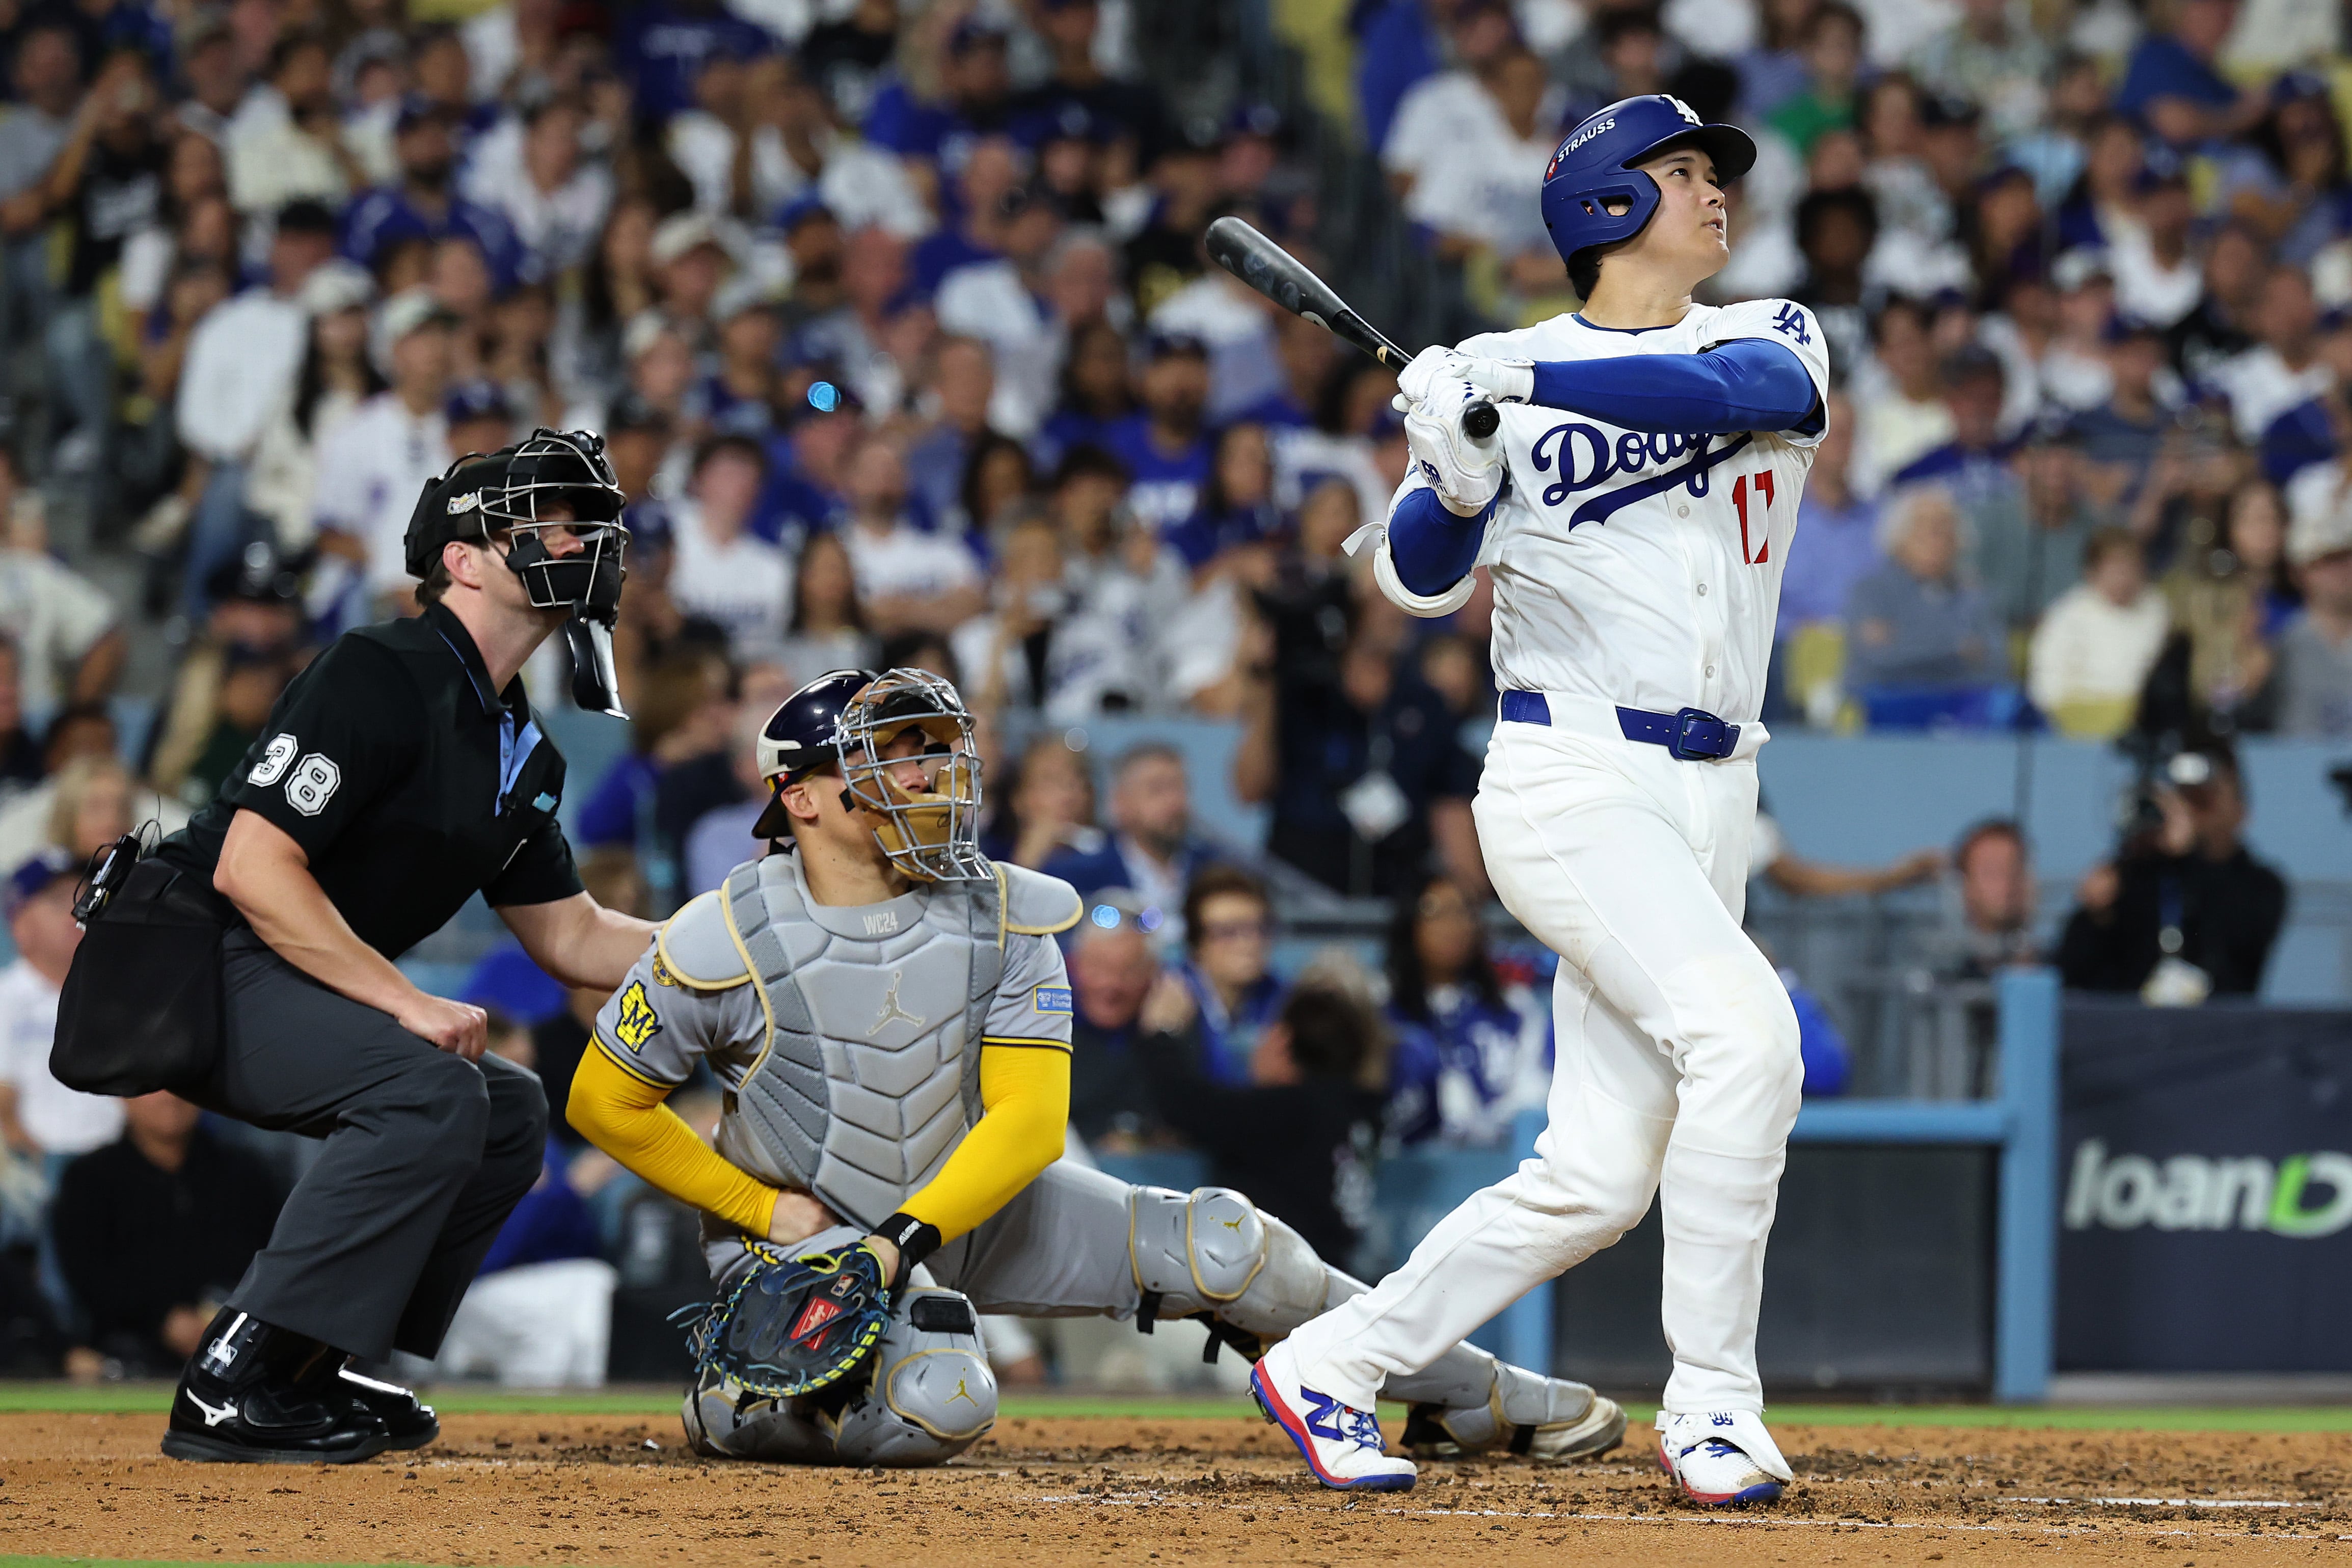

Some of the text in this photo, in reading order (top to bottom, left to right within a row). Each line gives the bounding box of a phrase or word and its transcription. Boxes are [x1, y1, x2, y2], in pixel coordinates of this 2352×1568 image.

[1558, 118, 1616, 163] STRAUSS
[1772, 303, 1811, 346] LA
[1732, 469, 1774, 565] 17
[248, 732, 341, 817] 38
[863, 911, 898, 935] WC24
